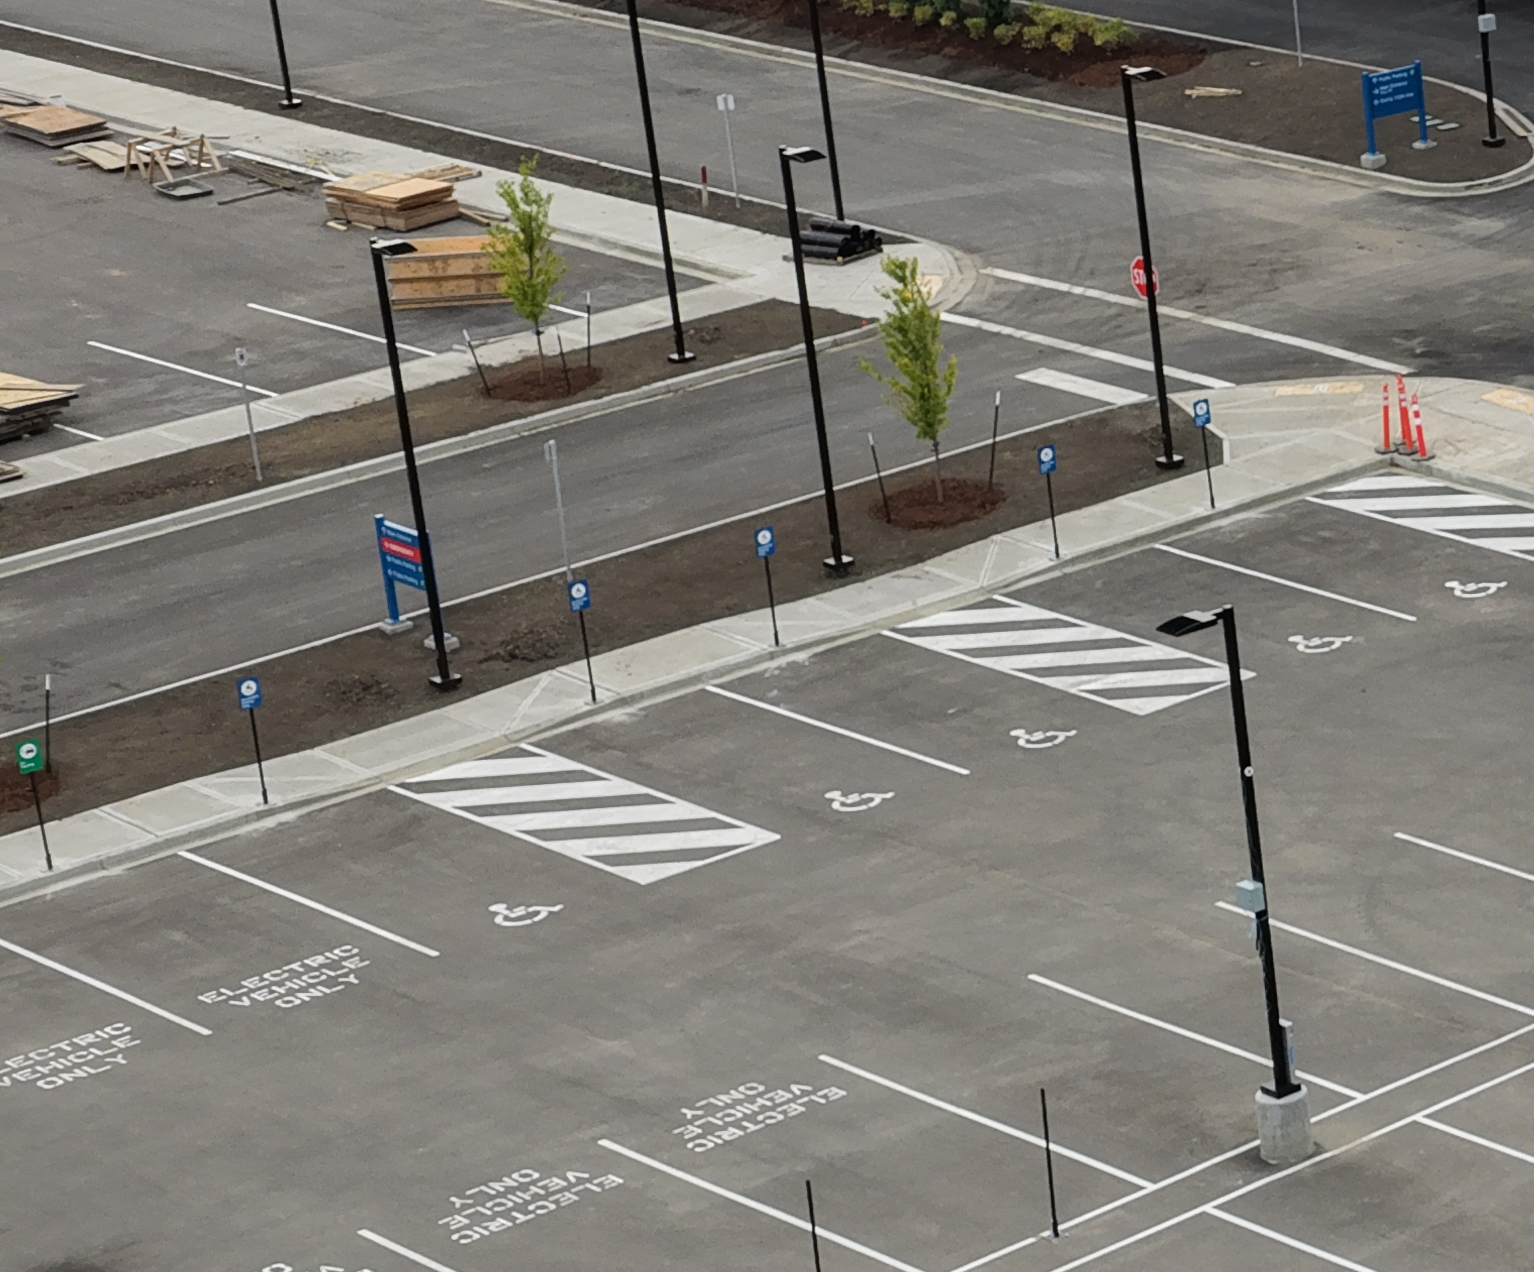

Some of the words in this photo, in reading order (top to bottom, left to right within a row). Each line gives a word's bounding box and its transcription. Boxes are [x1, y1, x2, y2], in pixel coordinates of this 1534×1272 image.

[1133, 268, 1157, 285] STP
[197, 944, 360, 1004] ELECTRIC
[228, 956, 371, 1007] VEHICLE
[274, 973, 360, 1008] ONLY
[36, 1053, 128, 1089] ONLY
[672, 1083, 813, 1139] VEHICLE
[680, 1082, 766, 1120] ONLY
[686, 1086, 848, 1152] ELECTRIC
[438, 1170, 590, 1230] VEHICLE
[449, 1168, 540, 1209] ONLY
[451, 1173, 624, 1244] ELECTRIC
